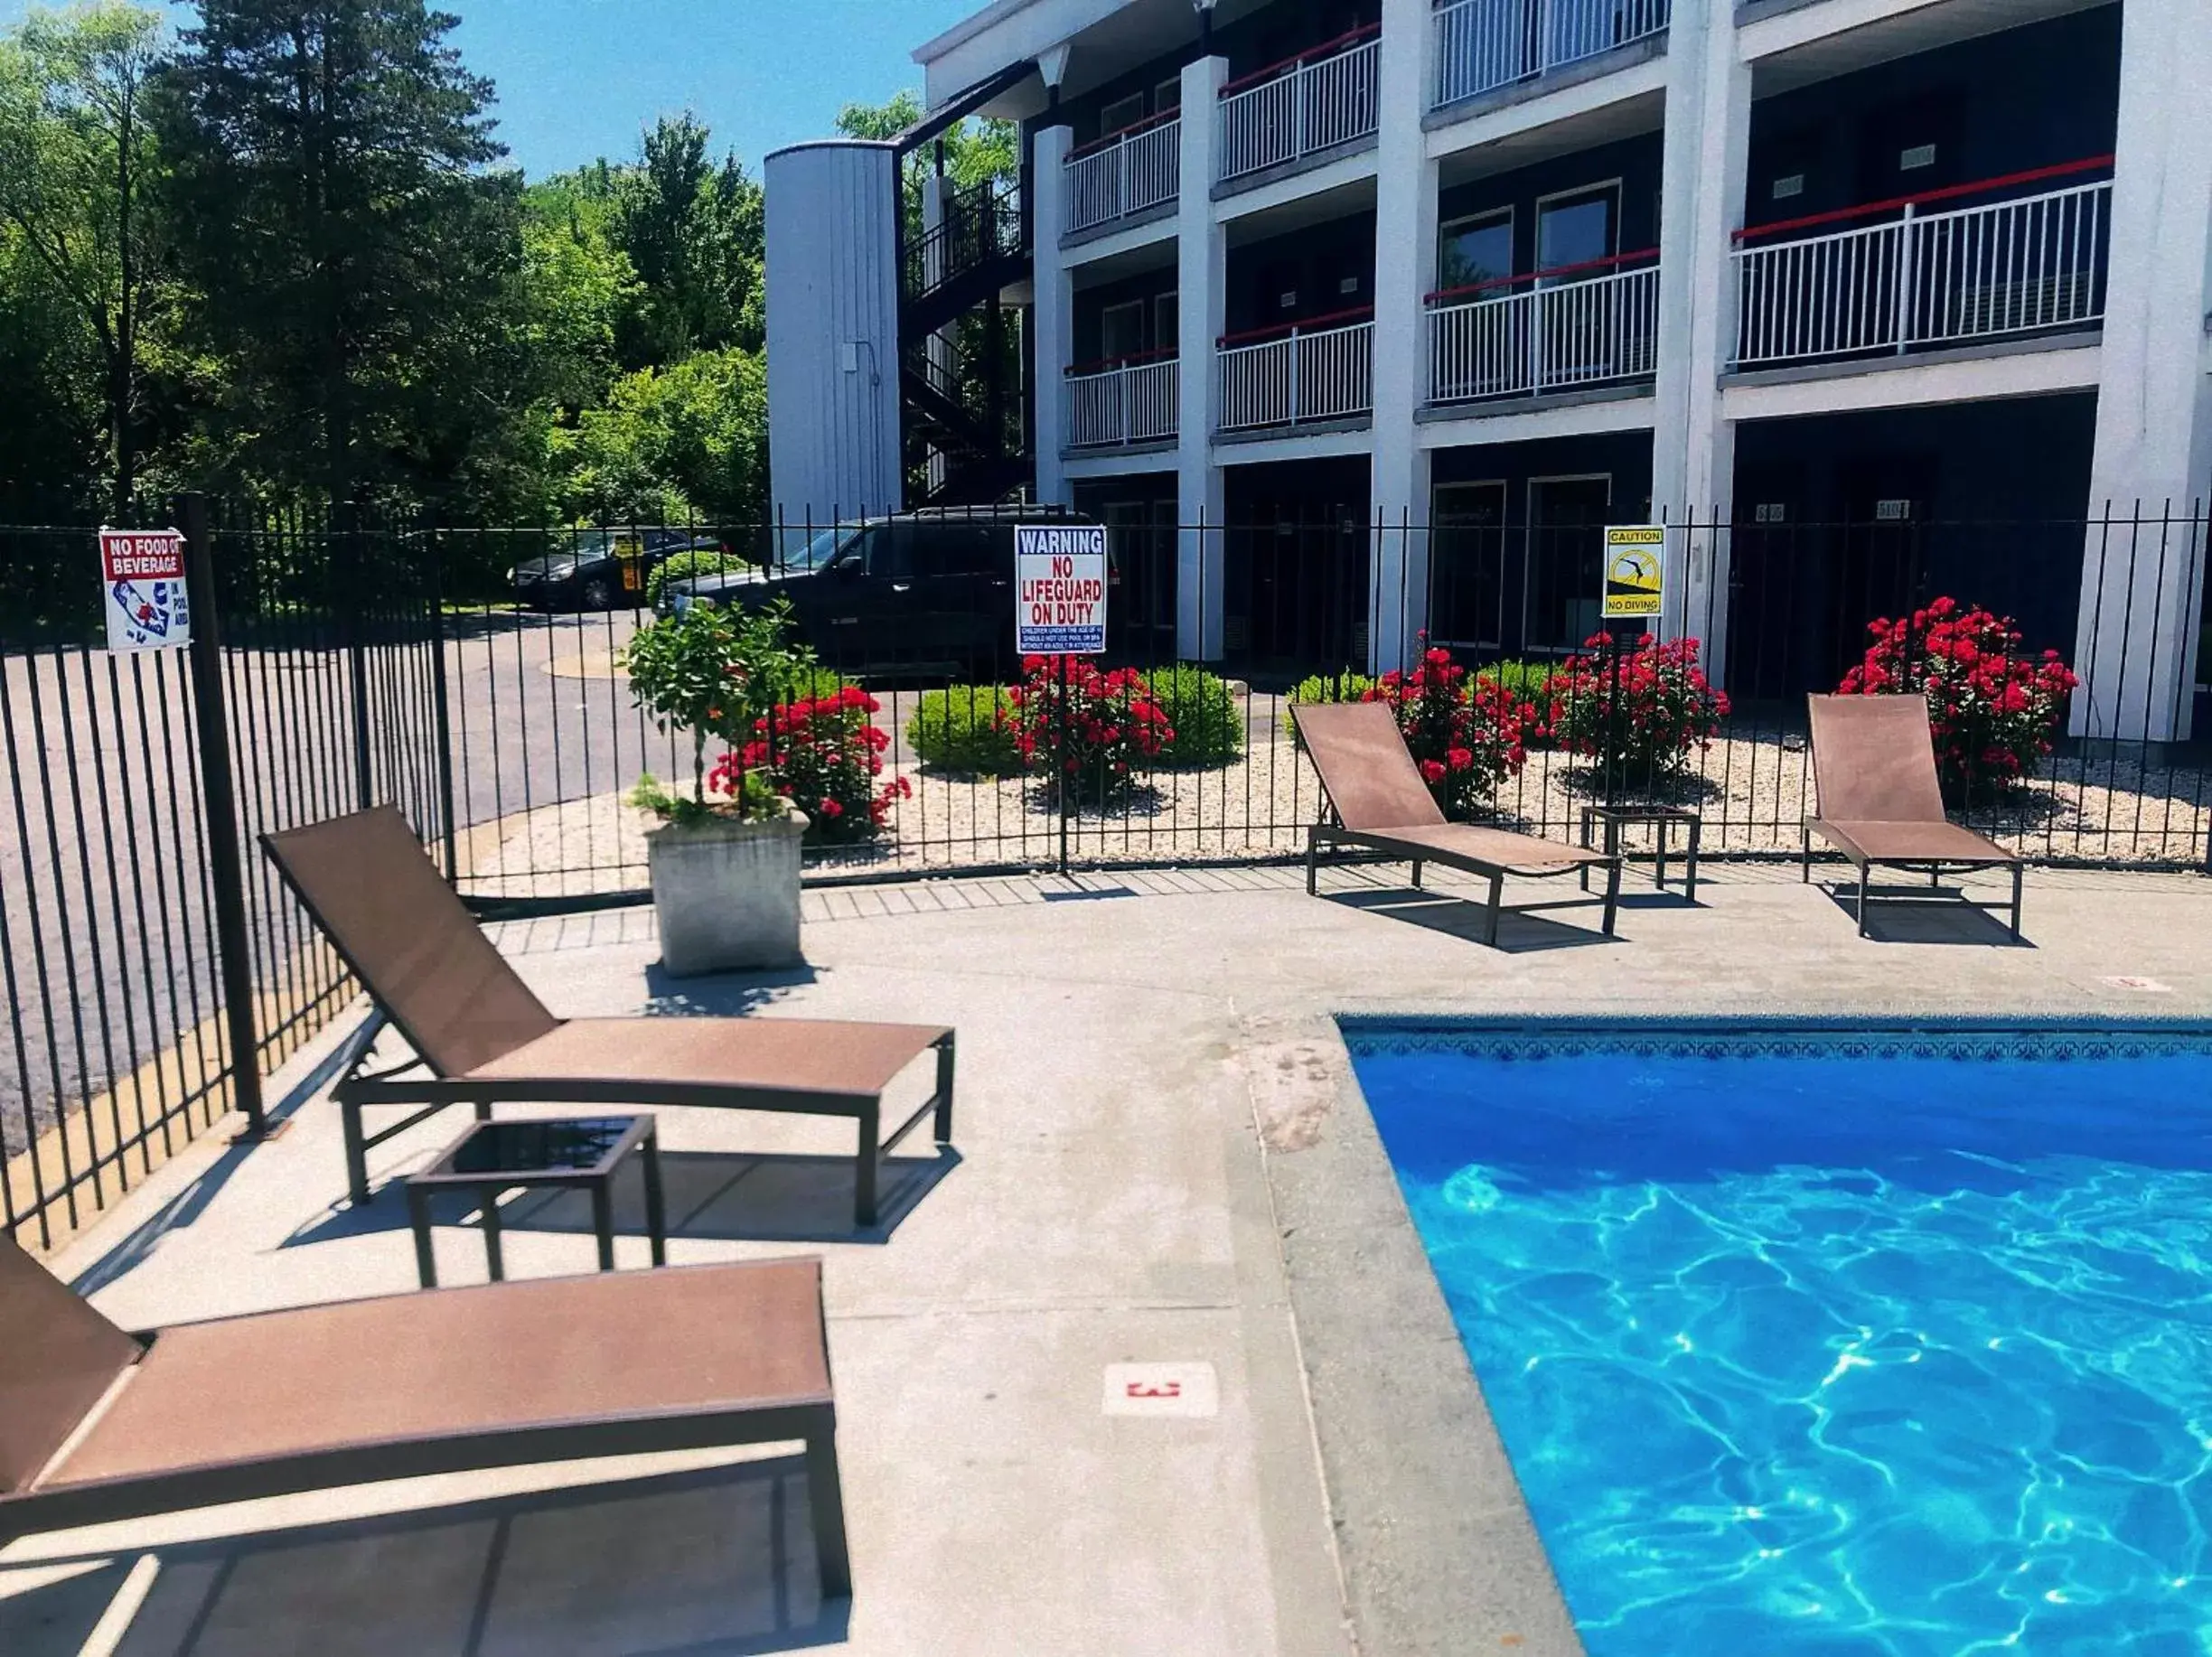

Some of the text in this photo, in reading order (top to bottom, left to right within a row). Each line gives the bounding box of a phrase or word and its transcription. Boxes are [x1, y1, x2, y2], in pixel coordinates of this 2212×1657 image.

[1020, 530, 1102, 554] WARNING
[1611, 531, 1660, 542] CAUTION
[109, 538, 132, 556] NO
[135, 538, 167, 555] FOOD
[113, 556, 178, 575] BEVERAGE
[1052, 556, 1073, 578] NO
[1022, 579, 1101, 603] LIFEGUARD
[1032, 603, 1092, 625] ON DUTY
[1608, 600, 1657, 610] NO DIVING
